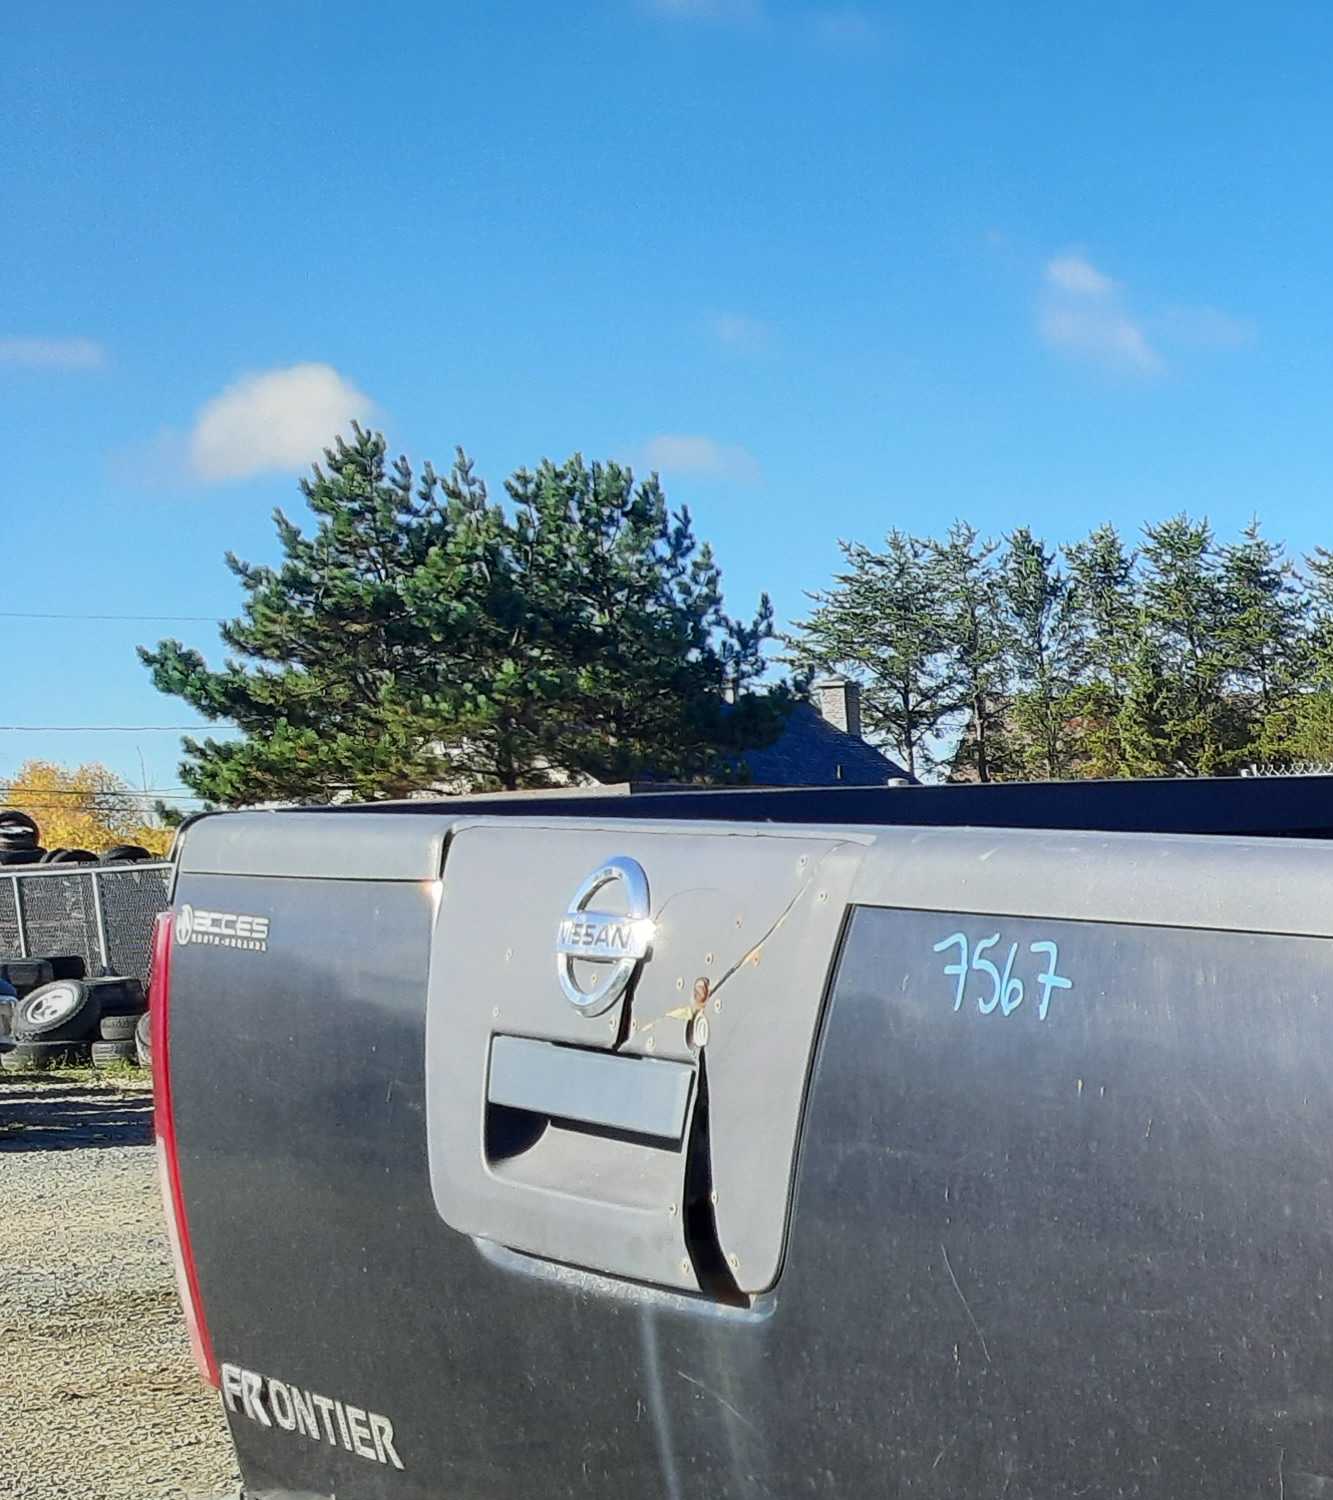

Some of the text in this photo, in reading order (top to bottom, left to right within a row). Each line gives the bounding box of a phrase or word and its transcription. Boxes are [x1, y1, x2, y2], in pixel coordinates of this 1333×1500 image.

[559, 920, 632, 950] NISSAN
[933, 932, 1072, 1020] 7567
[220, 1362, 405, 1471] FRONTIER
